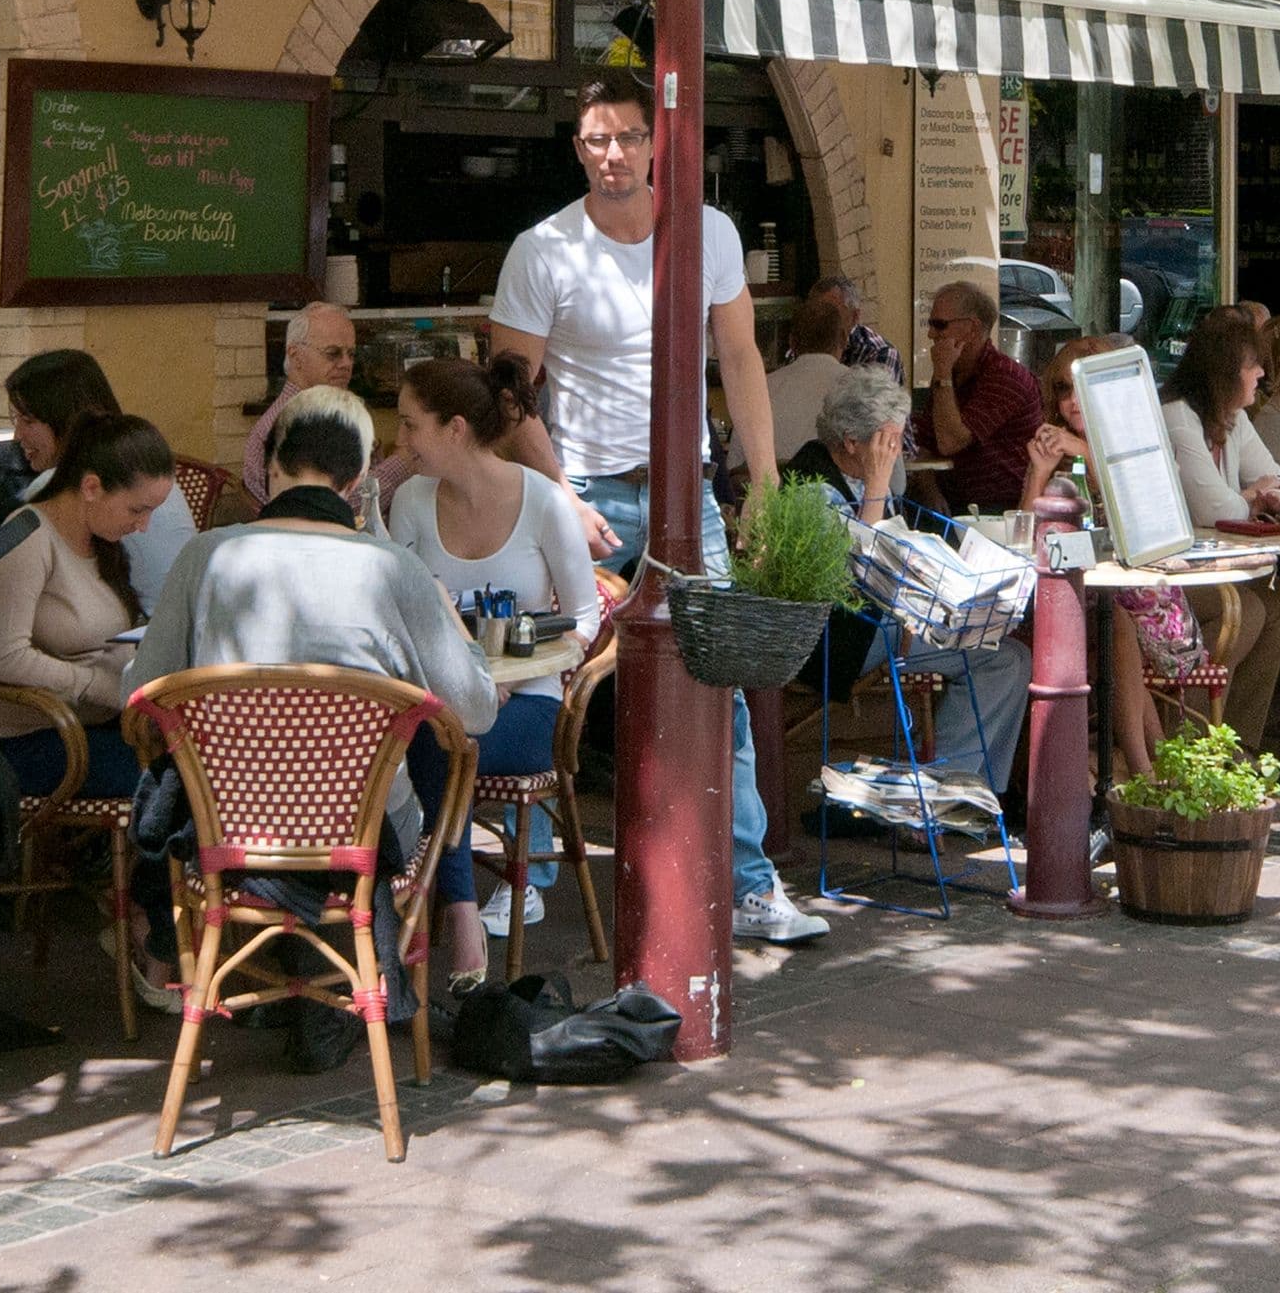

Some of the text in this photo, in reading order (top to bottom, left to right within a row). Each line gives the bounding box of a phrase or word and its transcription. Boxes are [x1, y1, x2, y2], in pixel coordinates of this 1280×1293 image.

[41, 95, 80, 115] Order
[920, 108, 954, 119] Discounts
[930, 122, 951, 132] Mixed
[952, 123, 973, 133] Dozen
[920, 138, 957, 148] purchases
[920, 164, 973, 176] Comprehensive
[928, 178, 947, 188] Event
[948, 178, 975, 189] Service
[121, 201, 234, 228] Melbourne Cup
[144, 222, 189, 242] Book
[945, 220, 973, 232] Delivery
